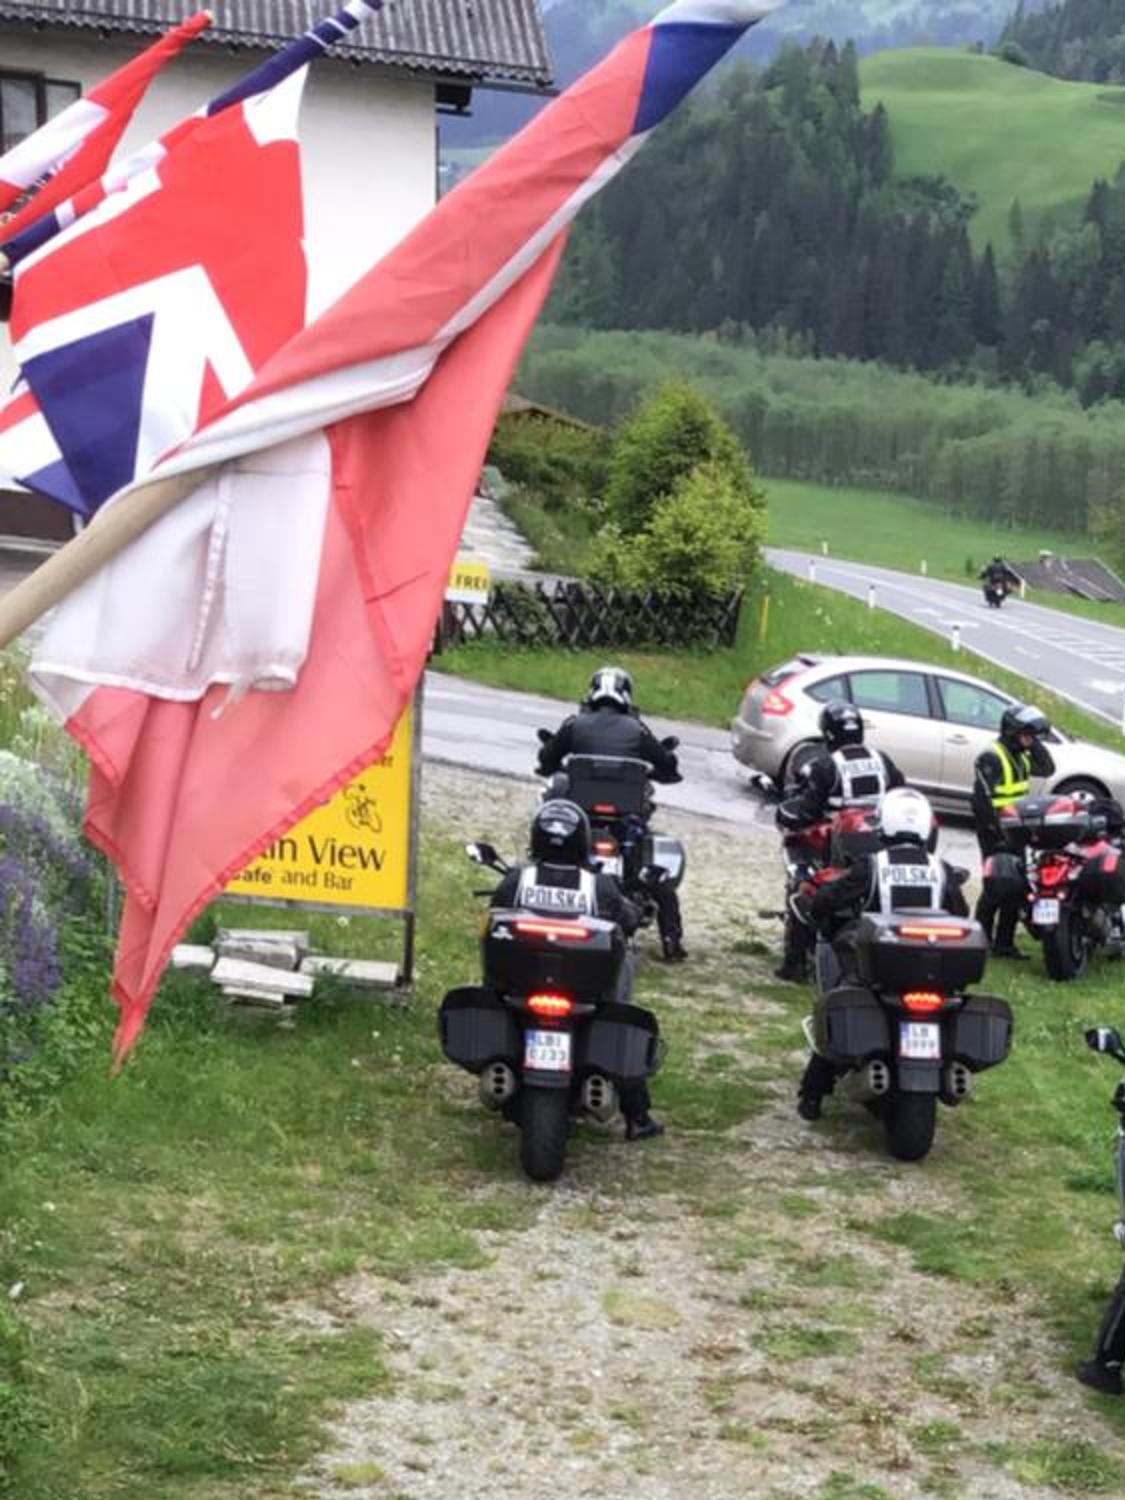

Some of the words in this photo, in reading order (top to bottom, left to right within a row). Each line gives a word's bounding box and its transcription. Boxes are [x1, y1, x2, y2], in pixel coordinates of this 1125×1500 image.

[307, 834, 386, 871] View
[281, 869, 318, 888] and
[323, 871, 353, 891] Bar
[880, 866, 939, 884] POLSKA
[524, 886, 586, 912] POLSKA
